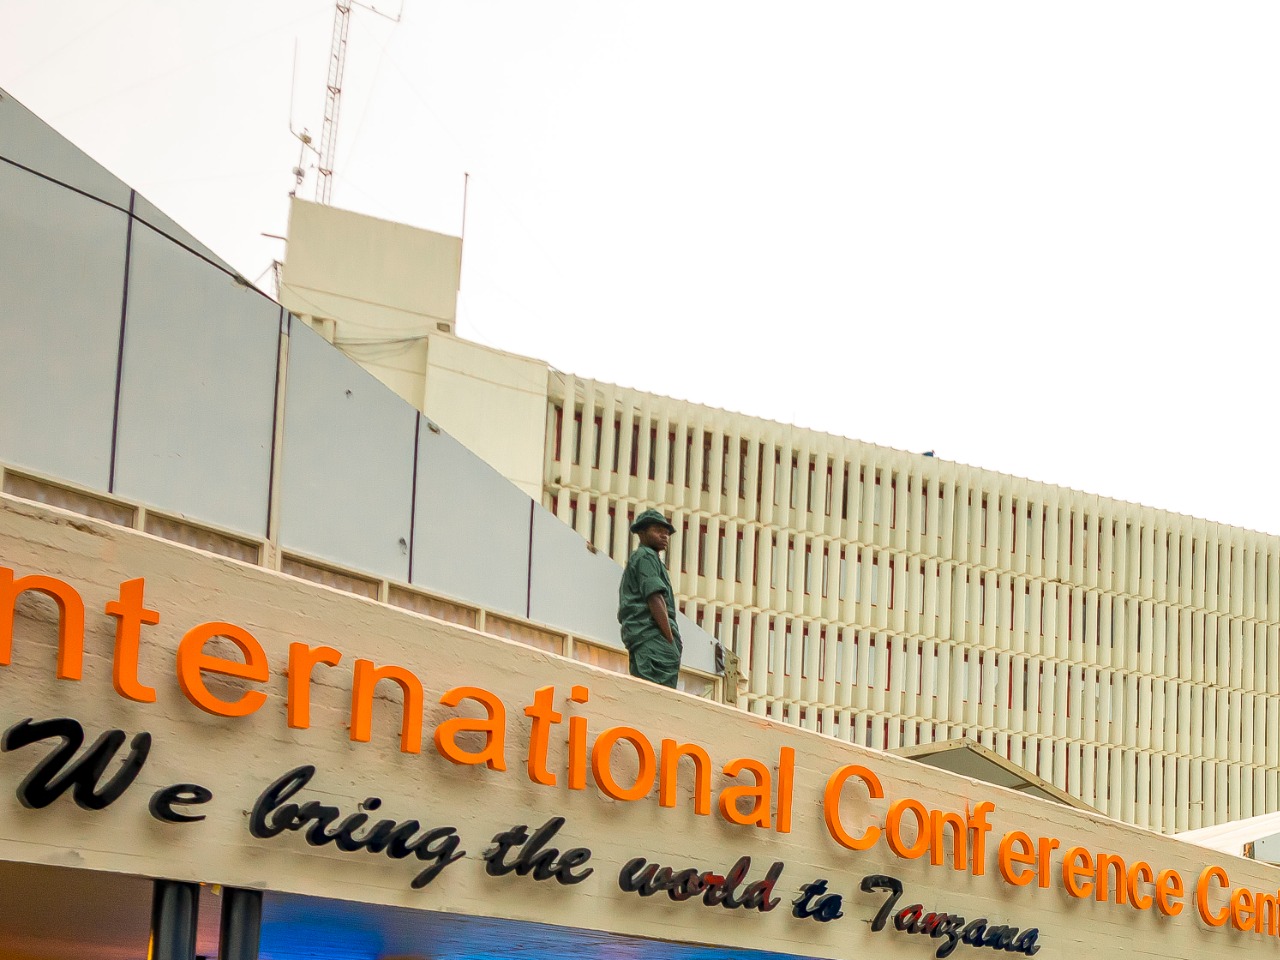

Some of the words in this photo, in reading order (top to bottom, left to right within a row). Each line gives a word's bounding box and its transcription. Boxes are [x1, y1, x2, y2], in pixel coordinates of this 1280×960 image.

[1, 716, 213, 825] We
[249, 764, 466, 889] bring
[484, 815, 594, 886] the
[619, 856, 784, 912] world
[791, 878, 844, 922] to
[823, 763, 1184, 916] Conference
